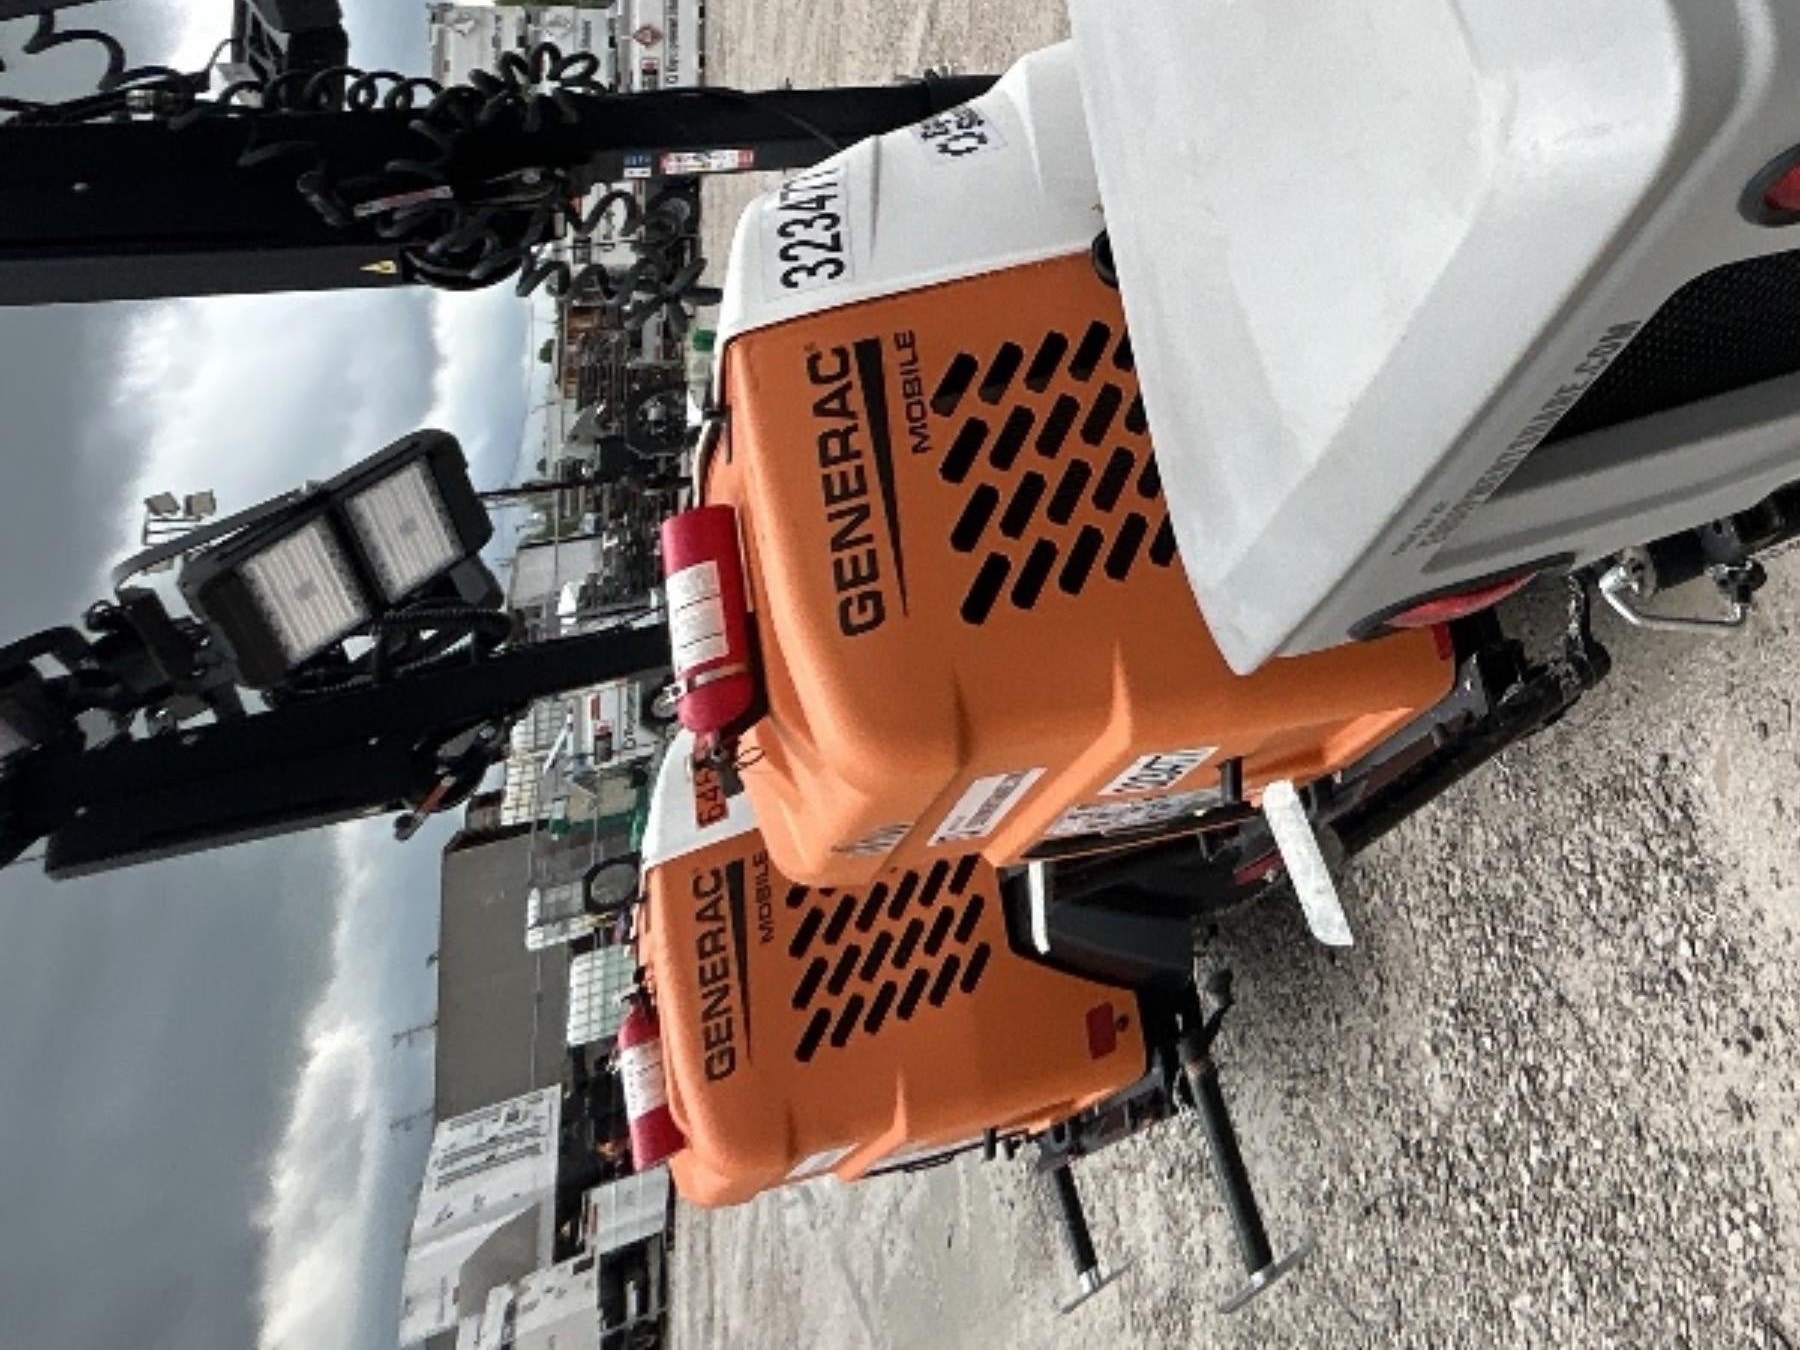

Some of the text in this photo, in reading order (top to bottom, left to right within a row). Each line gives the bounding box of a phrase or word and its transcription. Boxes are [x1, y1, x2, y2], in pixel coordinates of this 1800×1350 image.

[900, 330, 931, 455] MOBILE
[806, 345, 886, 637] GENERAC
[693, 868, 737, 1082] GENERAC
[752, 851, 774, 944] MOBILE
